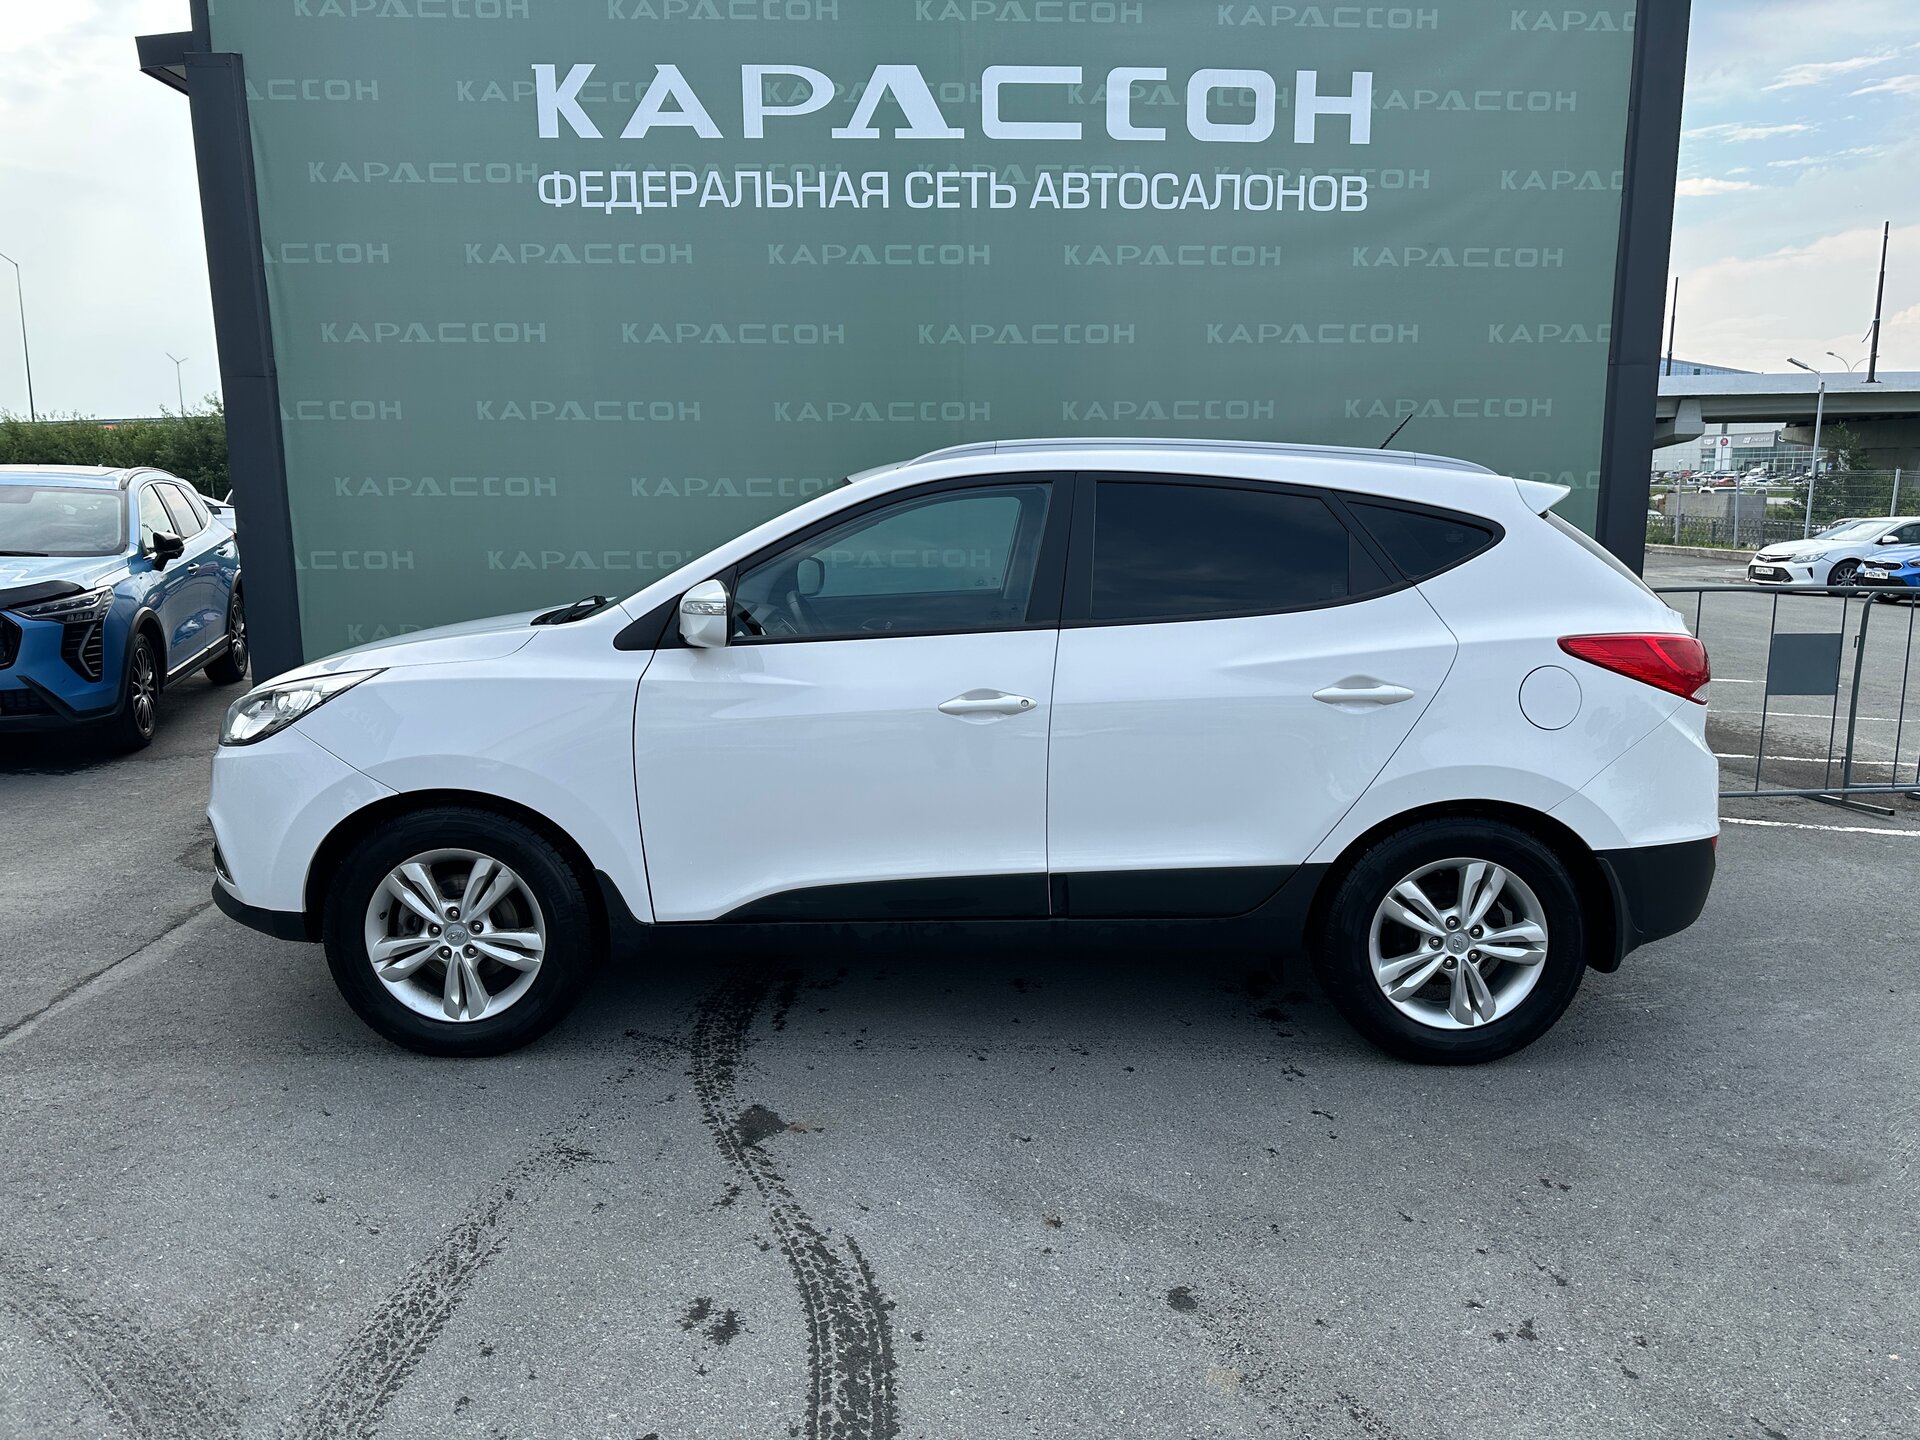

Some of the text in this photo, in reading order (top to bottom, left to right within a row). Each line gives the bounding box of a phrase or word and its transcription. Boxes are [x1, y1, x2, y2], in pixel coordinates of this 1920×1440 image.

[538, 171, 1368, 215] ФЕДЕРАЛЬНАЯ СЕТЬ АВТОСАЛОНОВ
